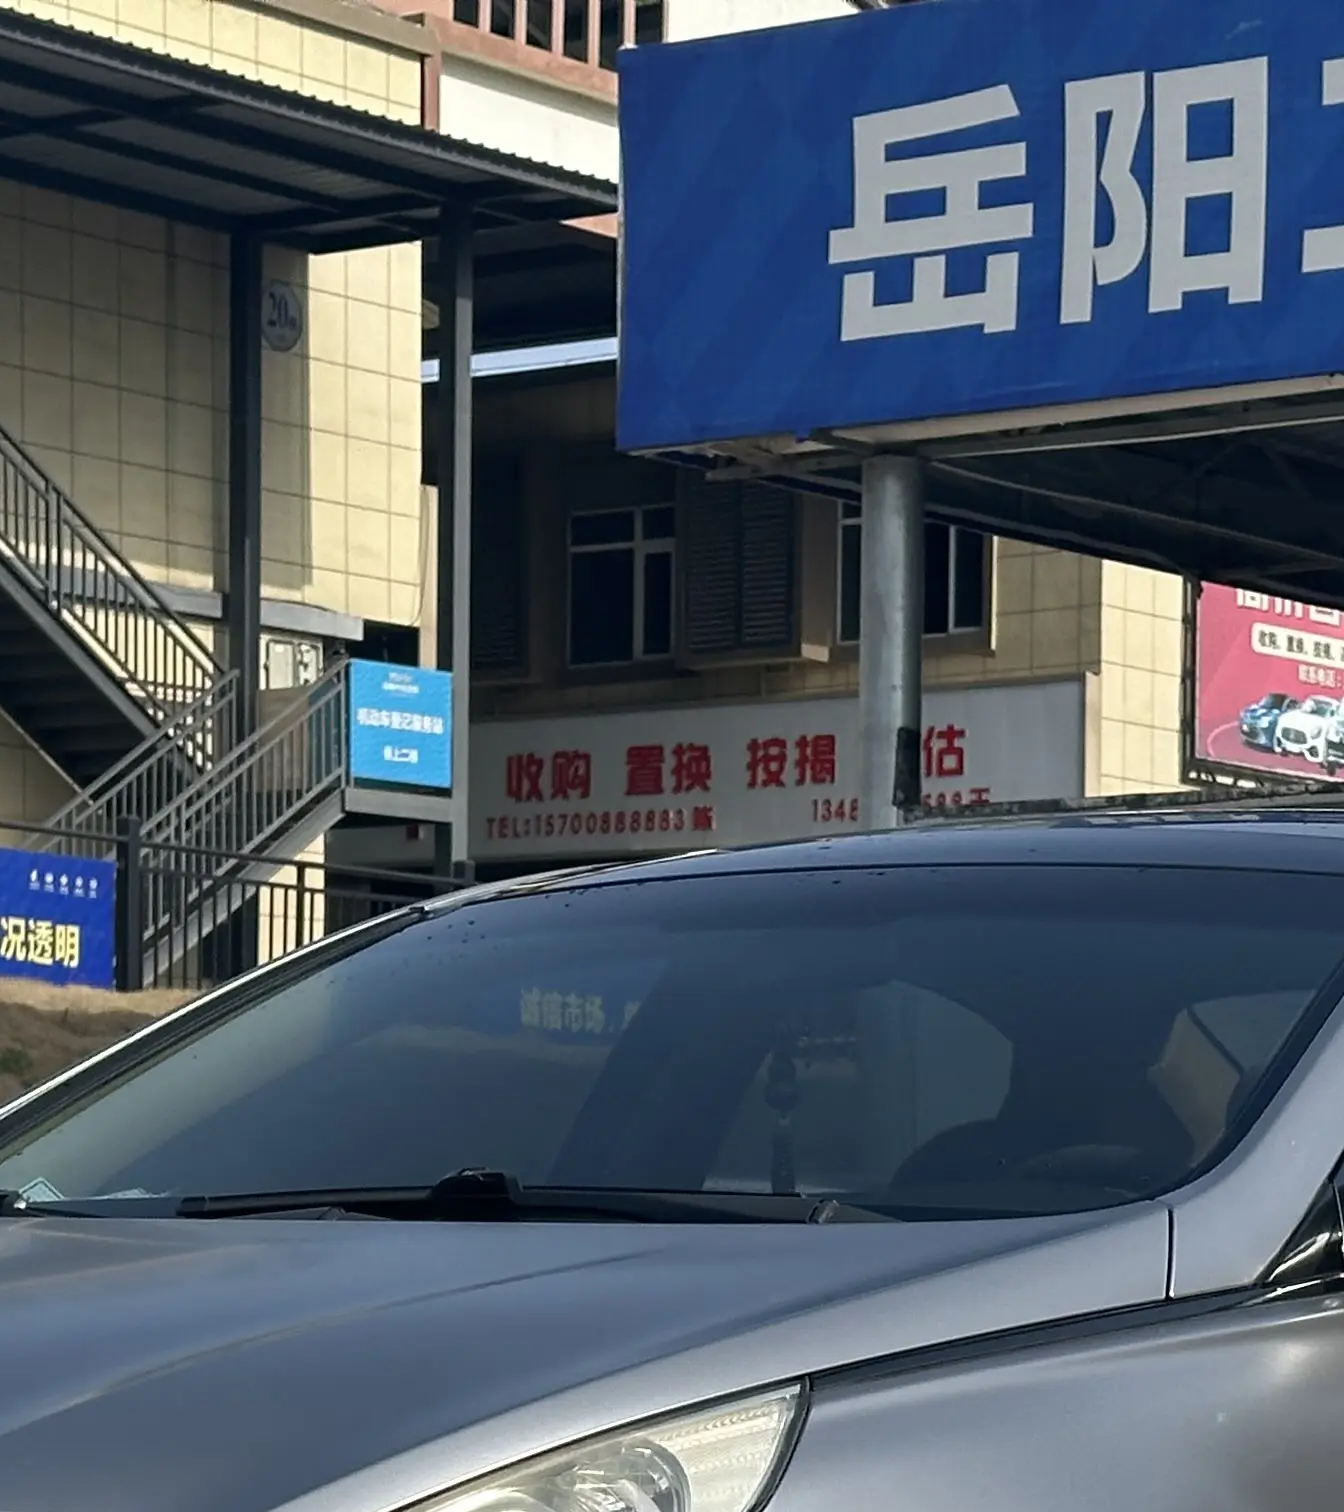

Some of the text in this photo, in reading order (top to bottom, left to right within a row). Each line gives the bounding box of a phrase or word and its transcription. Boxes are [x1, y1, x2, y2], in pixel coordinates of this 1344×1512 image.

[267, 291, 297, 331] 20
[506, 752, 591, 803] 收购
[625, 743, 712, 796] 置换
[746, 734, 836, 789] 按揭
